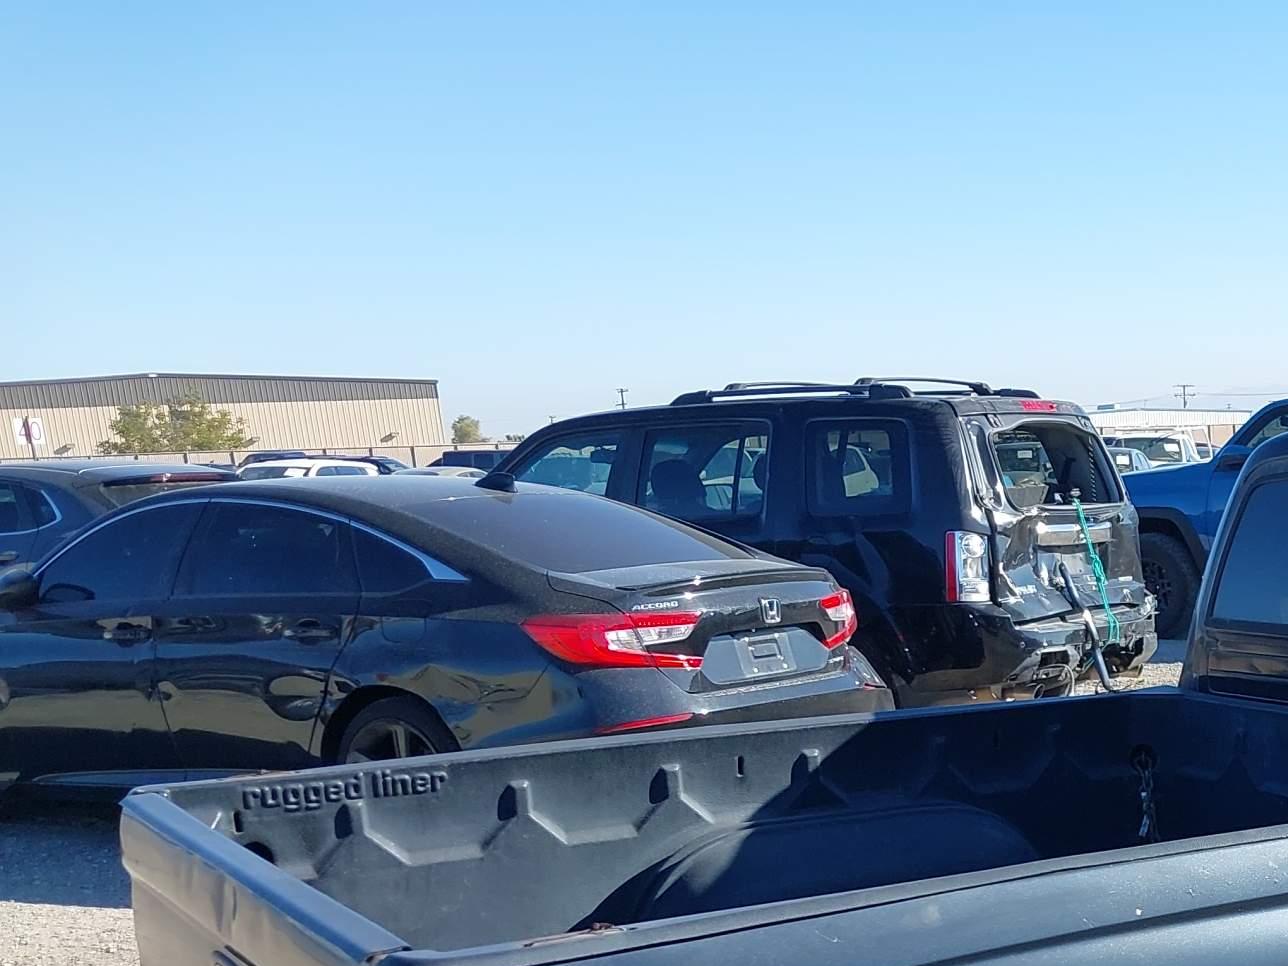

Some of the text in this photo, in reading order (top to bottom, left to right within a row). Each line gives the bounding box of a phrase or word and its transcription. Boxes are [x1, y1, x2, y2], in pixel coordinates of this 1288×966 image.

[631, 600, 680, 612] ACCORD
[242, 768, 448, 813] rugged liner
